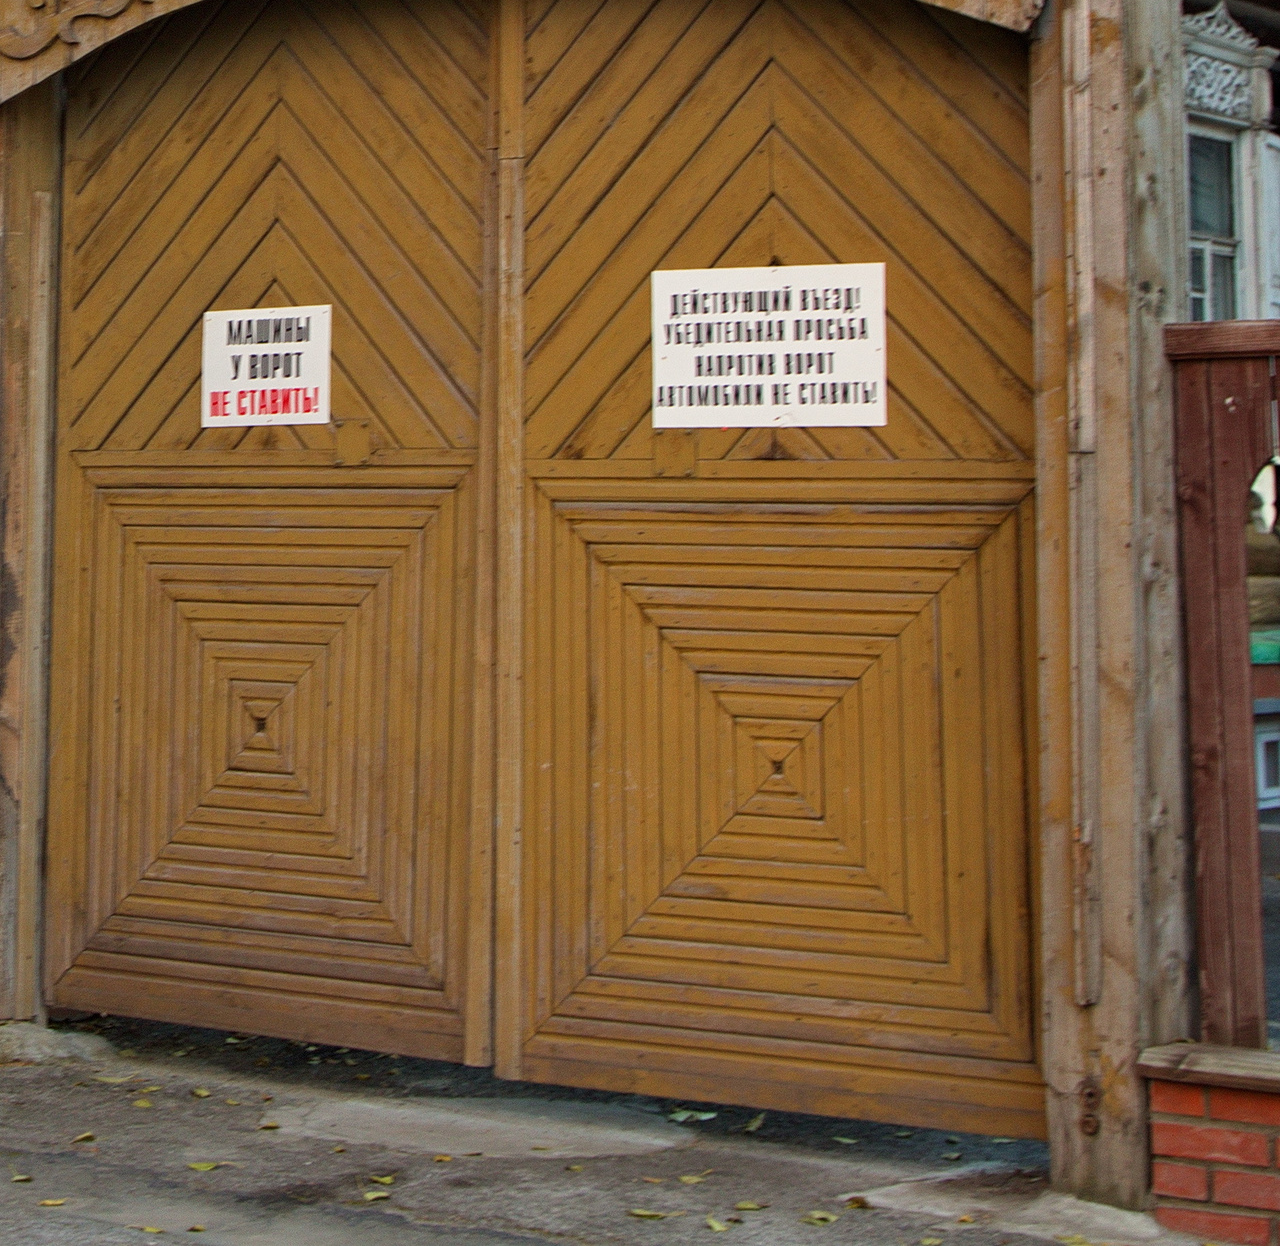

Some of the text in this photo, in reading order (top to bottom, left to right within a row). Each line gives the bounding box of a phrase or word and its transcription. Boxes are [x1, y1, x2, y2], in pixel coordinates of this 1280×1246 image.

[669, 285, 861, 319] ДЕЙСТВУЮЩИЙ ВЪЕЗД!
[226, 316, 311, 346] МАШИНЫ
[663, 317, 869, 348] УБЕДИТЕЛЬНАЯ ПРОСЬБА
[230, 352, 304, 381] У ВОРОТ
[694, 351, 835, 377] НАПРОТИВ ВОРОТ
[210, 387, 319, 417] НЕ СТАВИТЬ!
[656, 381, 878, 408] АВТОМОБИЛИ НЕ СТАВИТЬ!
